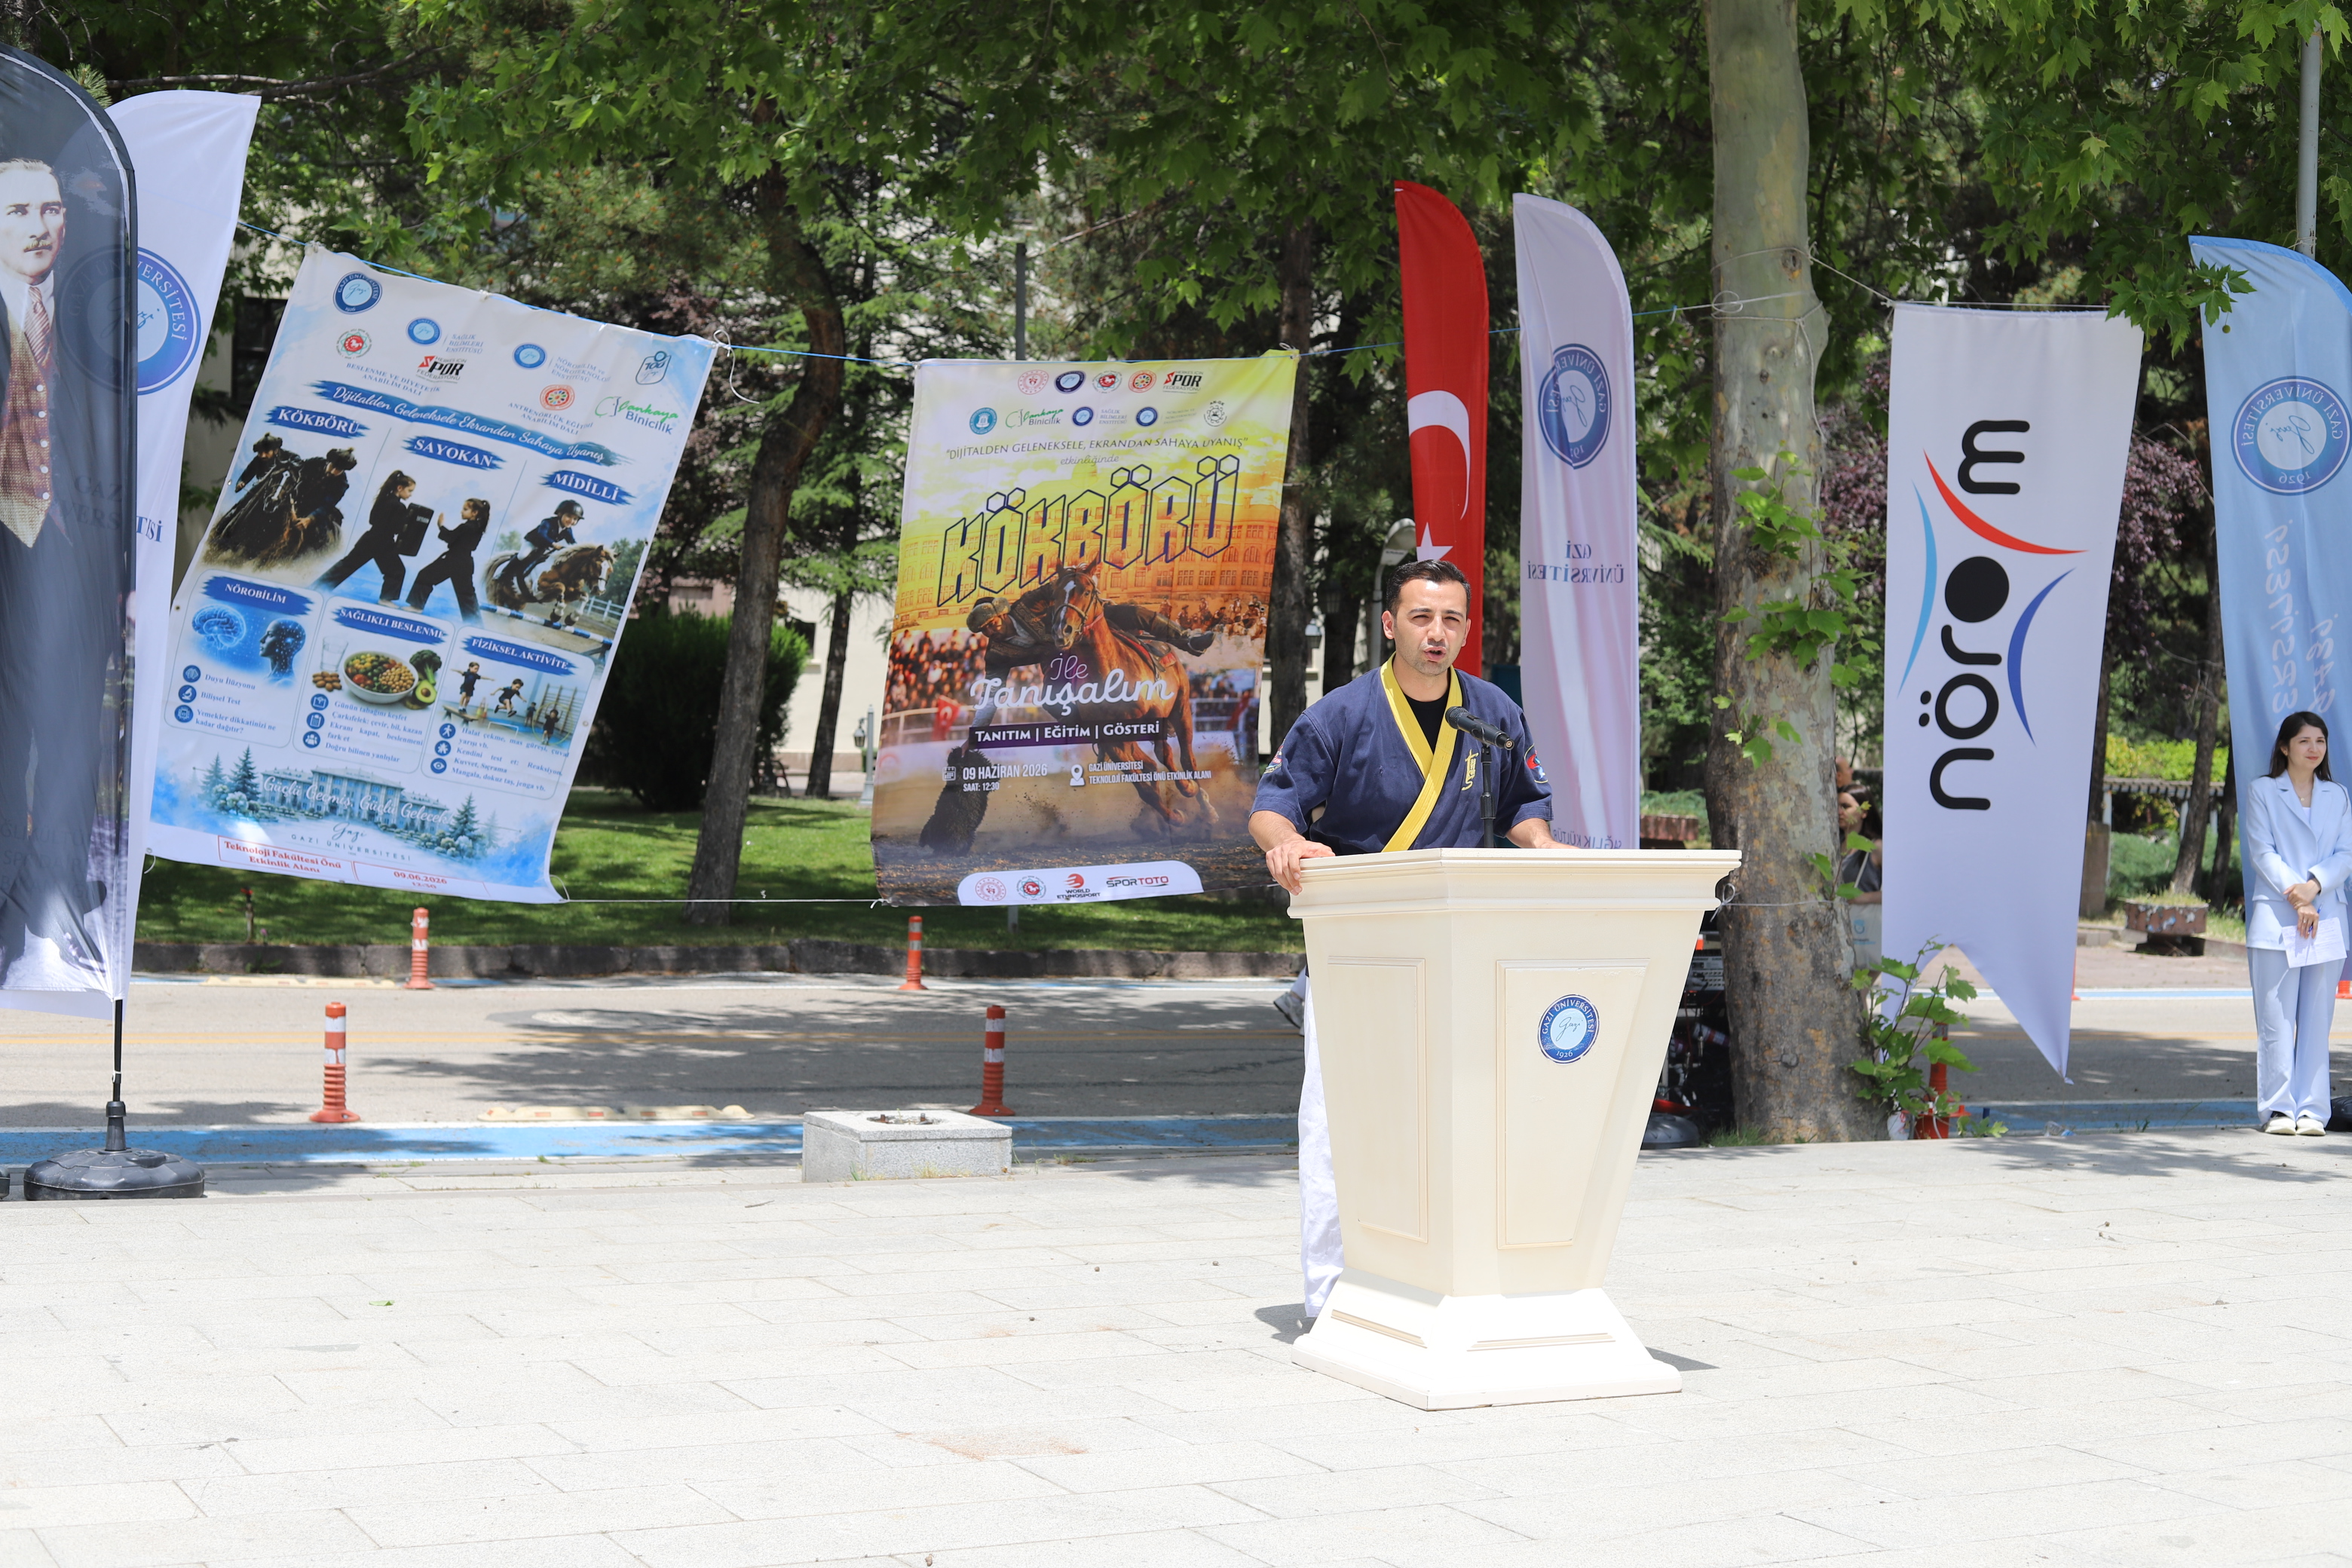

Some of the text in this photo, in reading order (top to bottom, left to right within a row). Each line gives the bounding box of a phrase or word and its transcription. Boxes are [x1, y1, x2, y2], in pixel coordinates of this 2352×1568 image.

[346, 363, 388, 378] BESLENME
[418, 355, 464, 375] SPOR
[362, 373, 401, 390] ANABİLİM
[403, 385, 422, 397] DALI
[1163, 371, 1202, 387] SPOR
[277, 408, 360, 435] KÖKBÖRÜ
[332, 386, 391, 411] Dijitalden
[458, 415, 516, 439] Ekrandan
[519, 431, 563, 456] Sahaya
[566, 444, 605, 463] Uyanış
[560, 424, 579, 436] DALI
[625, 411, 673, 435] Binicilik
[1028, 417, 1061, 426] Binicilik
[414, 439, 494, 467] SAYOKAN
[1012, 440, 1086, 453] GELENEKSELE,
[1089, 439, 1153, 449] EKRANDAN
[1154, 437, 1199, 449] SAHAYA
[1060, 454, 1119, 467] etkinliğinde
[553, 470, 620, 501] MİDİLLİ
[936, 454, 1240, 607] KÖKBÖRÜ
[225, 583, 286, 604] NÖROBİLİM
[339, 608, 388, 627] SAĞLIKLI
[471, 637, 569, 670] FİZİKSEL AKTİVİTE
[1049, 652, 1089, 681] İle
[204, 673, 225, 684] Duyu
[201, 691, 241, 706] Bilişsel Test
[969, 668, 1175, 716] Tanışalım
[197, 709, 228, 721] Yemekler
[230, 714, 267, 729] dikkatinizi
[334, 700, 408, 722] Günün tabağını keşfet
[195, 718, 244, 733] kadar dağıtır?
[329, 721, 354, 732] Ekranı
[386, 733, 424, 747] beslenmeni
[403, 725, 423, 736] kazan
[461, 727, 480, 737] Halat
[327, 732, 343, 742] fark
[325, 742, 400, 764] Doğru bilinen yanlışlar
[456, 747, 483, 758] Kendini
[491, 754, 503, 763] test
[480, 761, 507, 775] Sıçrama
[962, 763, 1048, 781] 09 HAZİRAN 2026
[1089, 759, 1144, 772] GAZİ ÜNİVERSİTESİ
[482, 773, 503, 783] dokuz
[516, 779, 534, 790] jenga
[1089, 770, 1212, 785] TEKNOLOJİ FAKÜLTESİ ÖNÜ ETKİNLİK ALANI
[963, 782, 1000, 792] SAAT: 12:30
[223, 841, 341, 869] Teknoloji Fakültesi Önü
[249, 856, 320, 873] Etkinlik Alanı
[393, 871, 448, 885] 09.06.2026
[1056, 891, 1101, 899] ETHNOSPORT
[1556, 1050, 1573, 1058] 1926
